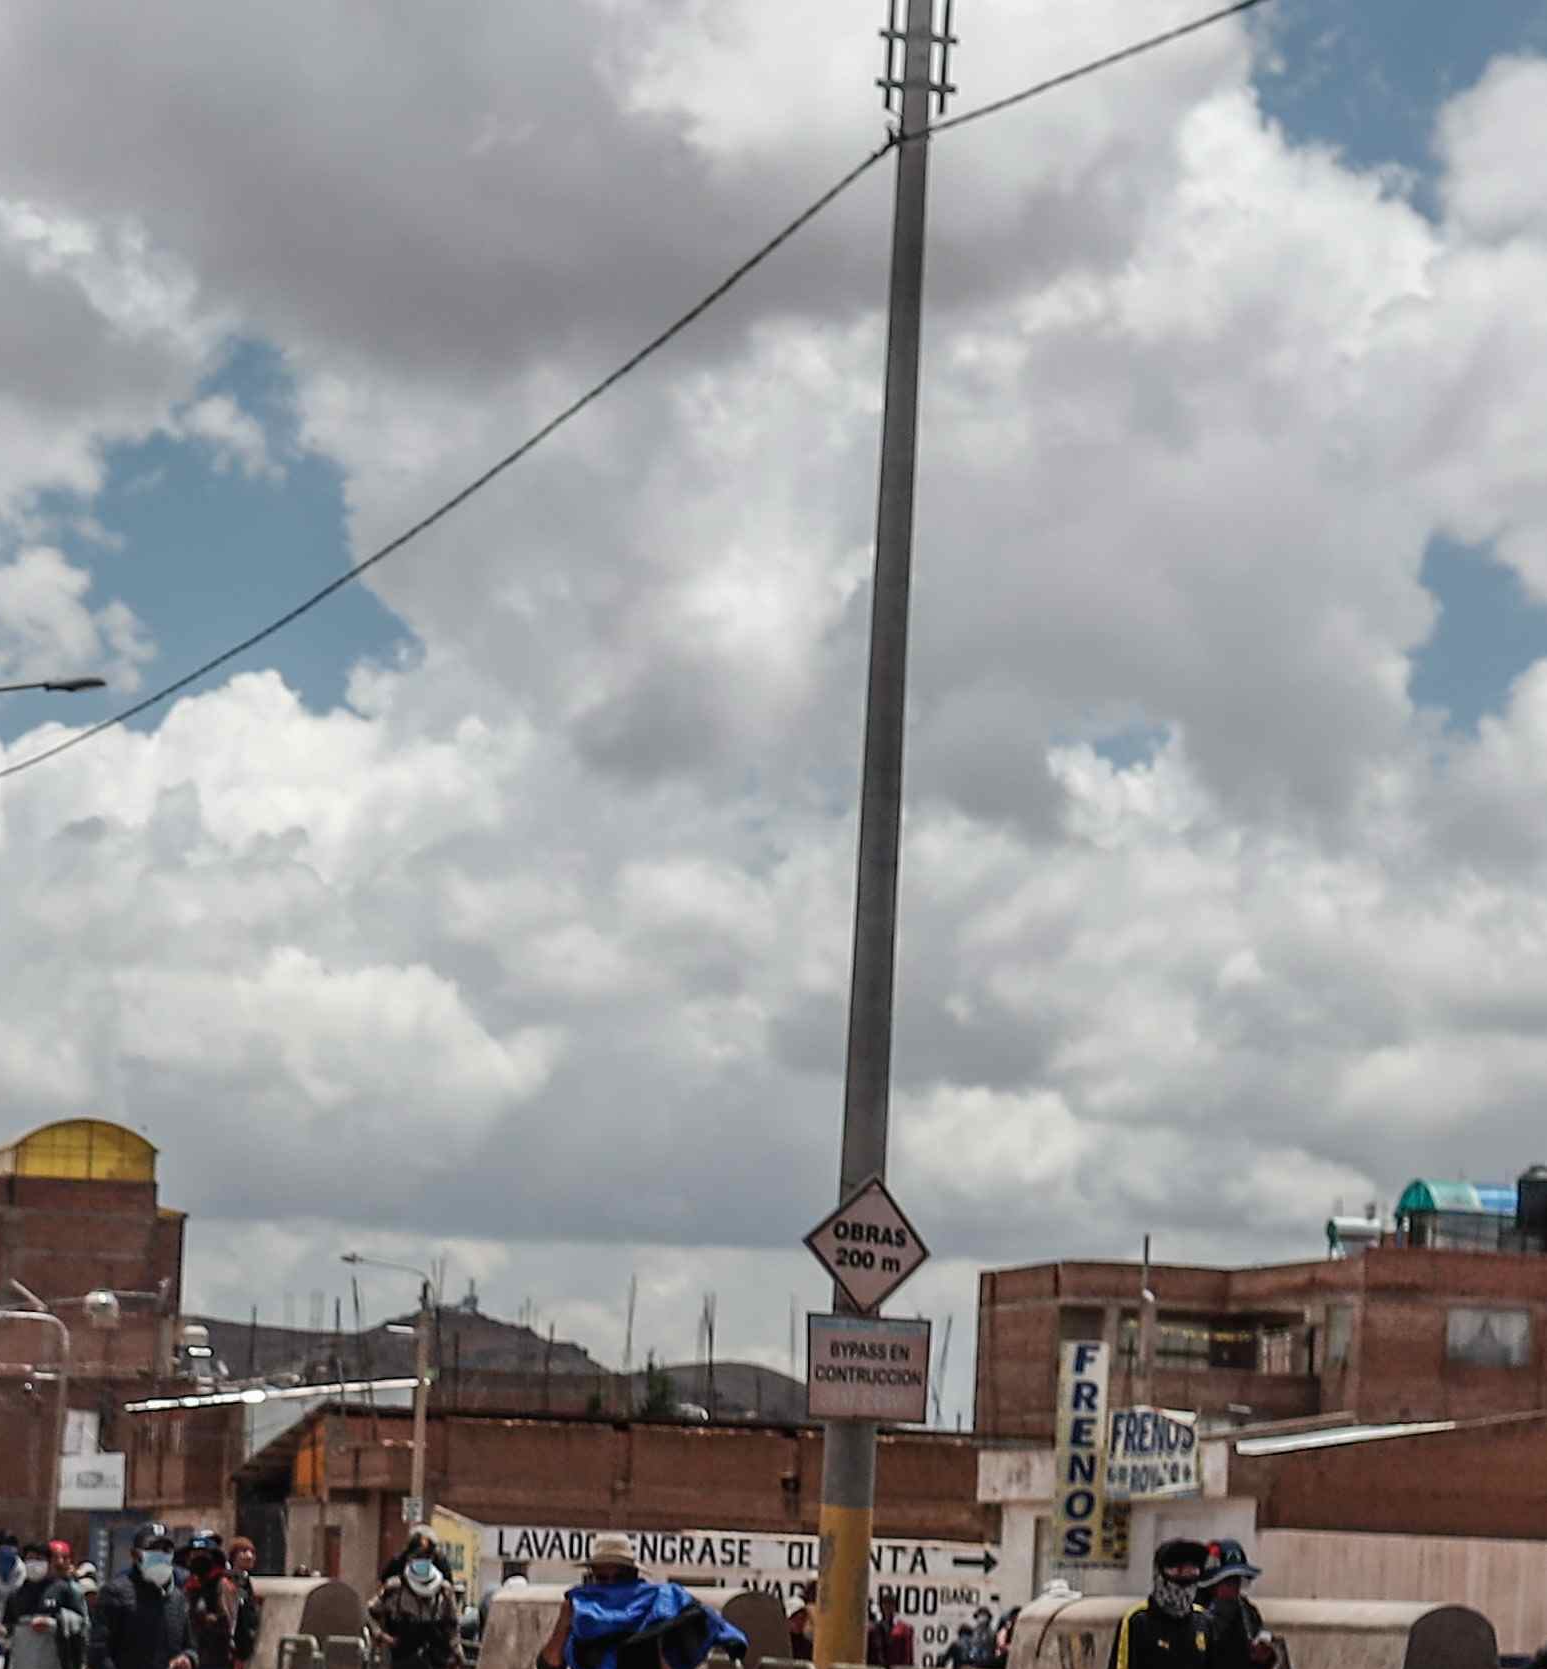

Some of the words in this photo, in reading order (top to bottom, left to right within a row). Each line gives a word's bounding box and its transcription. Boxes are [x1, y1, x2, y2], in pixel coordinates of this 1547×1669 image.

[832, 1220, 907, 1249] OBRAS
[835, 1249, 875, 1270] 200
[880, 1257, 901, 1273] m
[830, 1340, 887, 1360] BYPASS
[889, 1343, 910, 1361] EN
[1064, 1343, 1100, 1558] FRENOS
